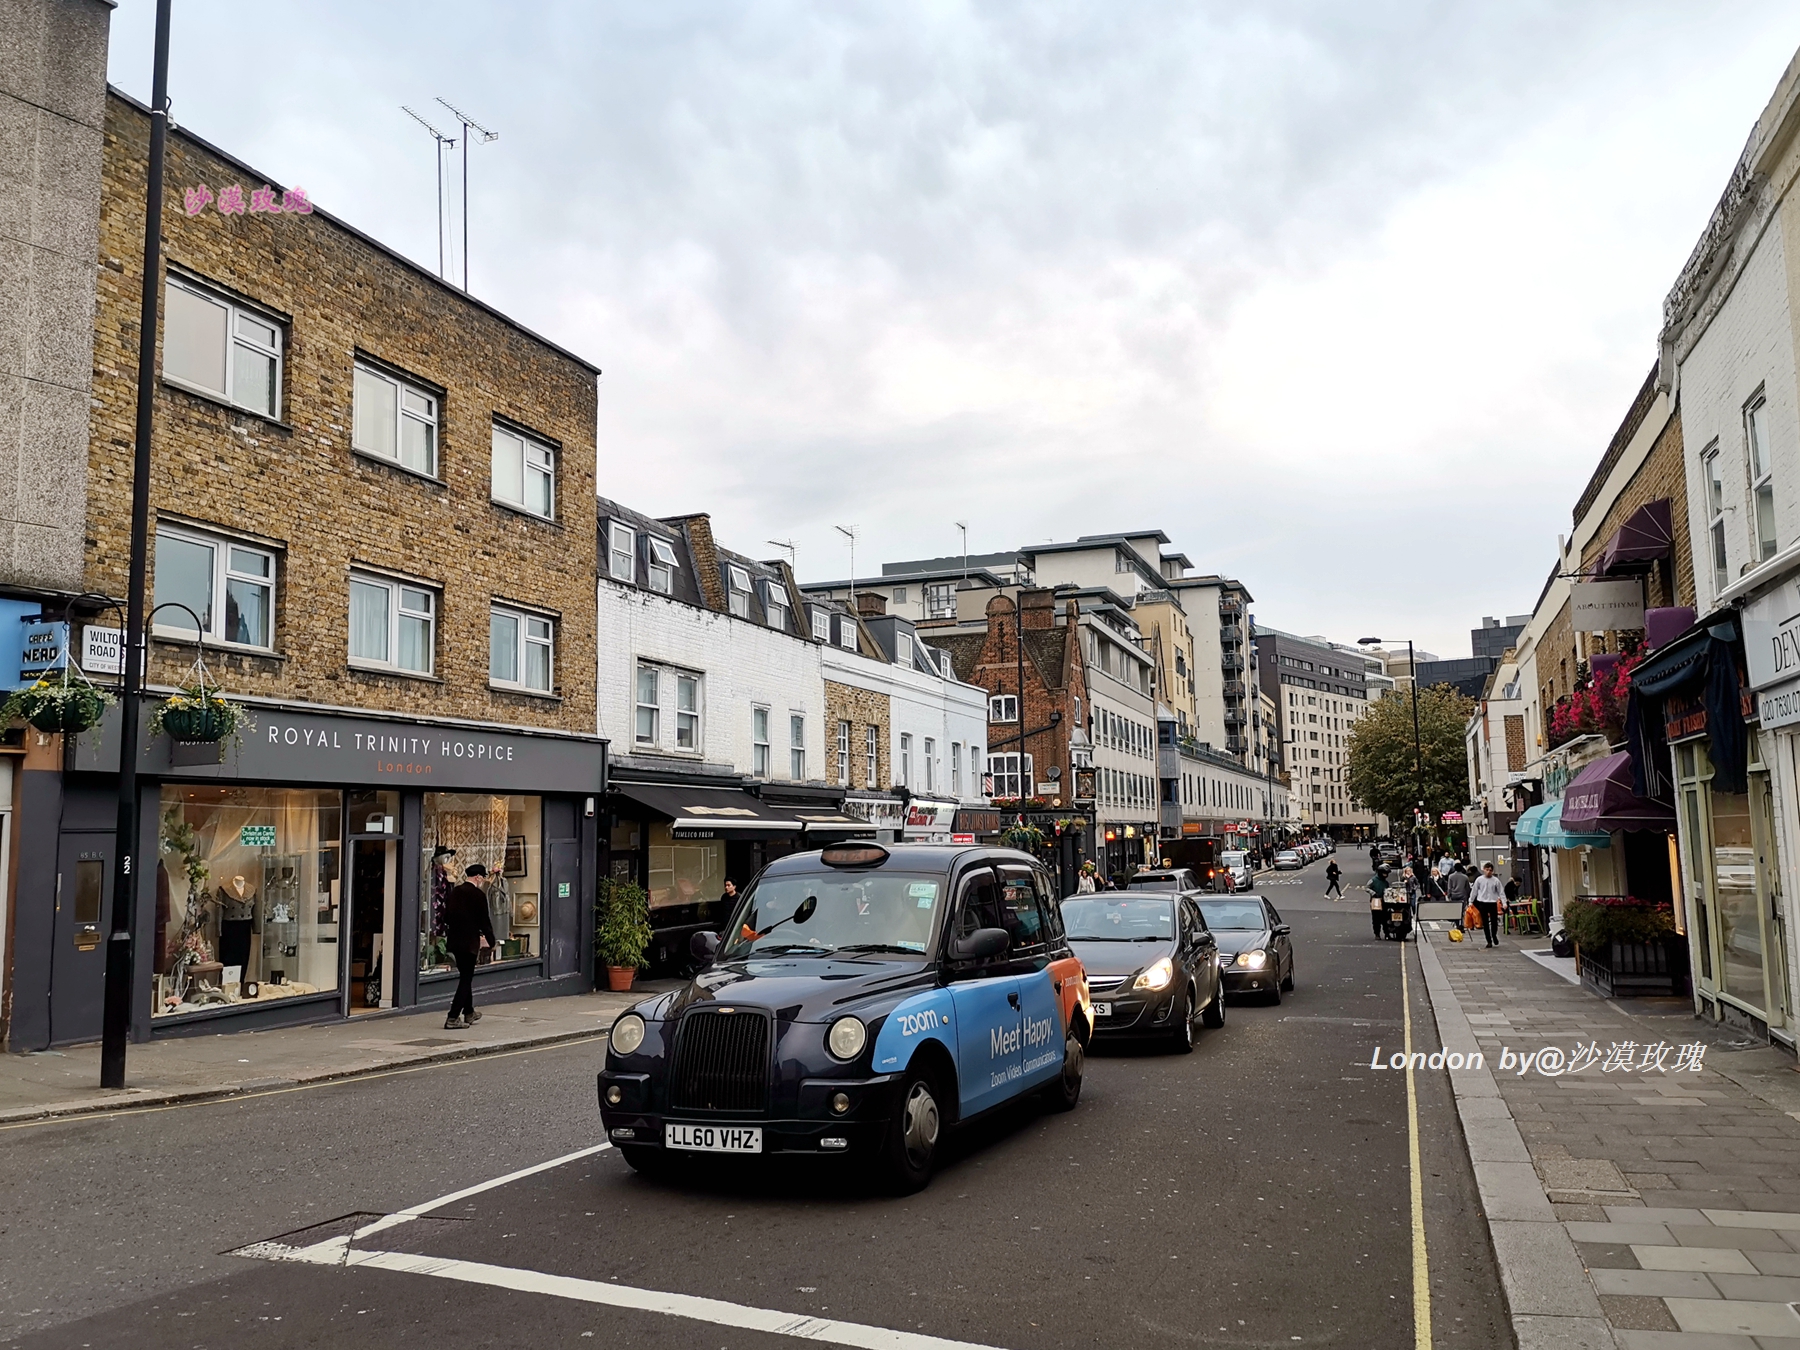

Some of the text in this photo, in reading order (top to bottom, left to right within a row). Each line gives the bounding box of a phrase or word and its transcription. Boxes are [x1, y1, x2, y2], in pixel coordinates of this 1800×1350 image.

[1576, 601, 1640, 610] ABOUT THYME
[90, 630, 124, 645] WILTO
[23, 646, 58, 663] NERO
[90, 644, 116, 658] ROAD
[1762, 699, 1774, 721] 020
[1774, 694, 1792, 719] 7630
[268, 725, 513, 761] ROYAL TRINITY HOSPICE
[377, 760, 432, 774] London
[897, 1009, 939, 1036] zoom
[991, 1016, 1053, 1059] Meet Happy.
[990, 1050, 1056, 1088] Zoom Video Communications
[672, 1126, 754, 1149] LL60 VHZ
